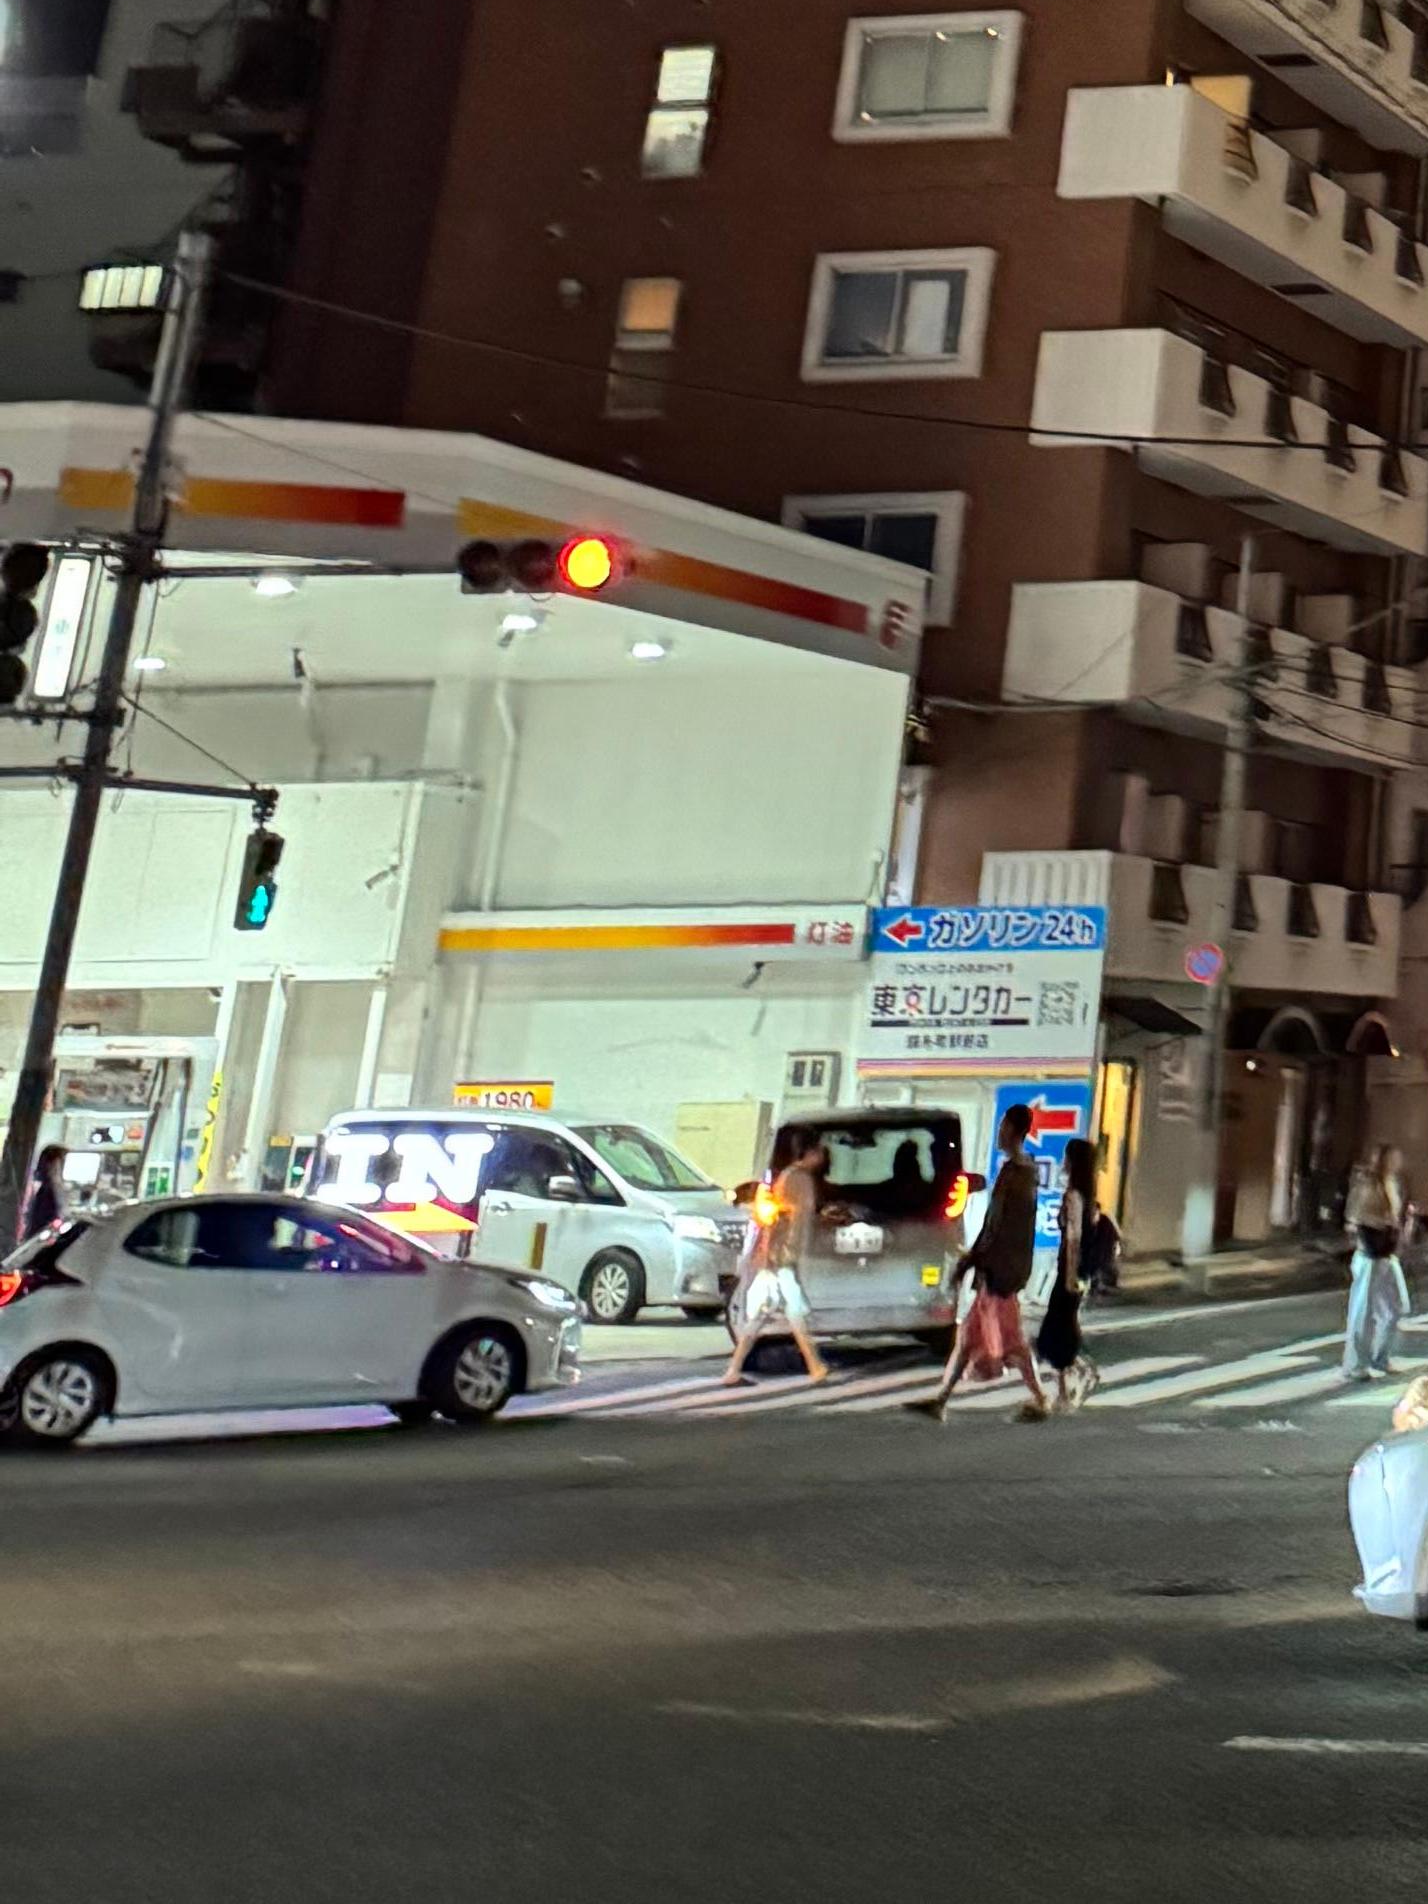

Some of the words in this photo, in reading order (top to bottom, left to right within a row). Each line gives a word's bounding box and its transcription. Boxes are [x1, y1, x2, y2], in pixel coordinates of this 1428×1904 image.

[928, 911, 1038, 947] ガソリン
[1042, 911, 1097, 944] 24h
[870, 983, 1033, 1016] 東京レンタカー
[316, 1133, 495, 1205] IN
